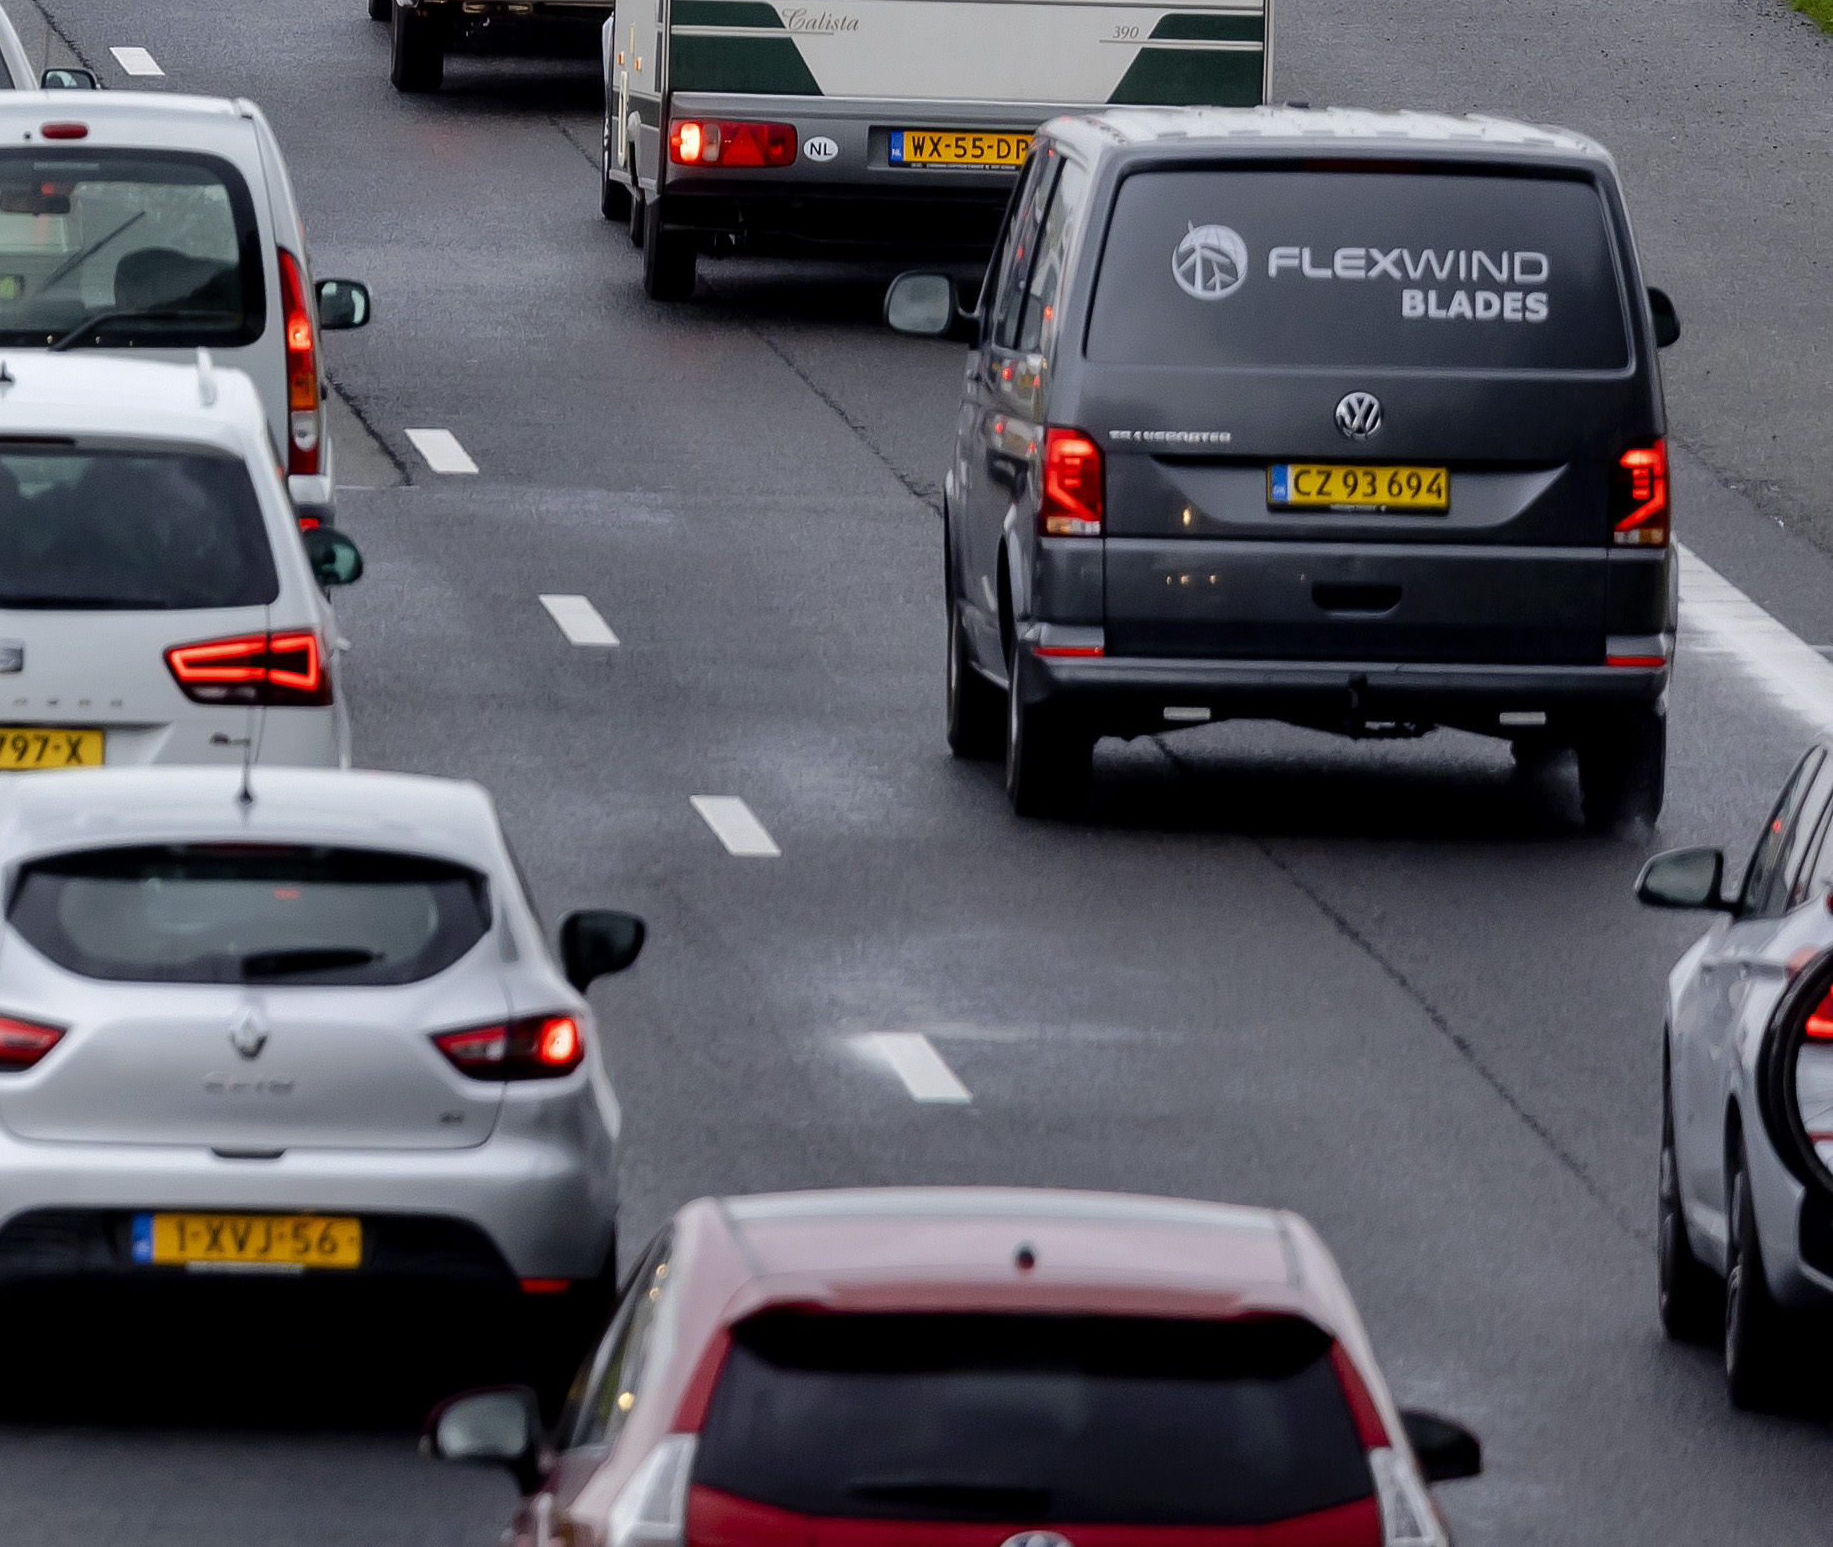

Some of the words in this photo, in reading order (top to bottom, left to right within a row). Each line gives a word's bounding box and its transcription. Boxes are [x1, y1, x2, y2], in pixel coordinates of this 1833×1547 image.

[782, 8, 859, 31] Calista
[1112, 25, 1140, 39] 390
[809, 142, 833, 156] NL
[911, 135, 1030, 160] WX-55-DP
[1267, 246, 1549, 284] FLEXWIND
[1401, 288, 1549, 322] BLADES
[1294, 469, 1334, 497] CZ
[1342, 469, 1378, 499] 93
[1387, 470, 1444, 499] 694
[175, 1218, 339, 1253] 1-XVJ-56
